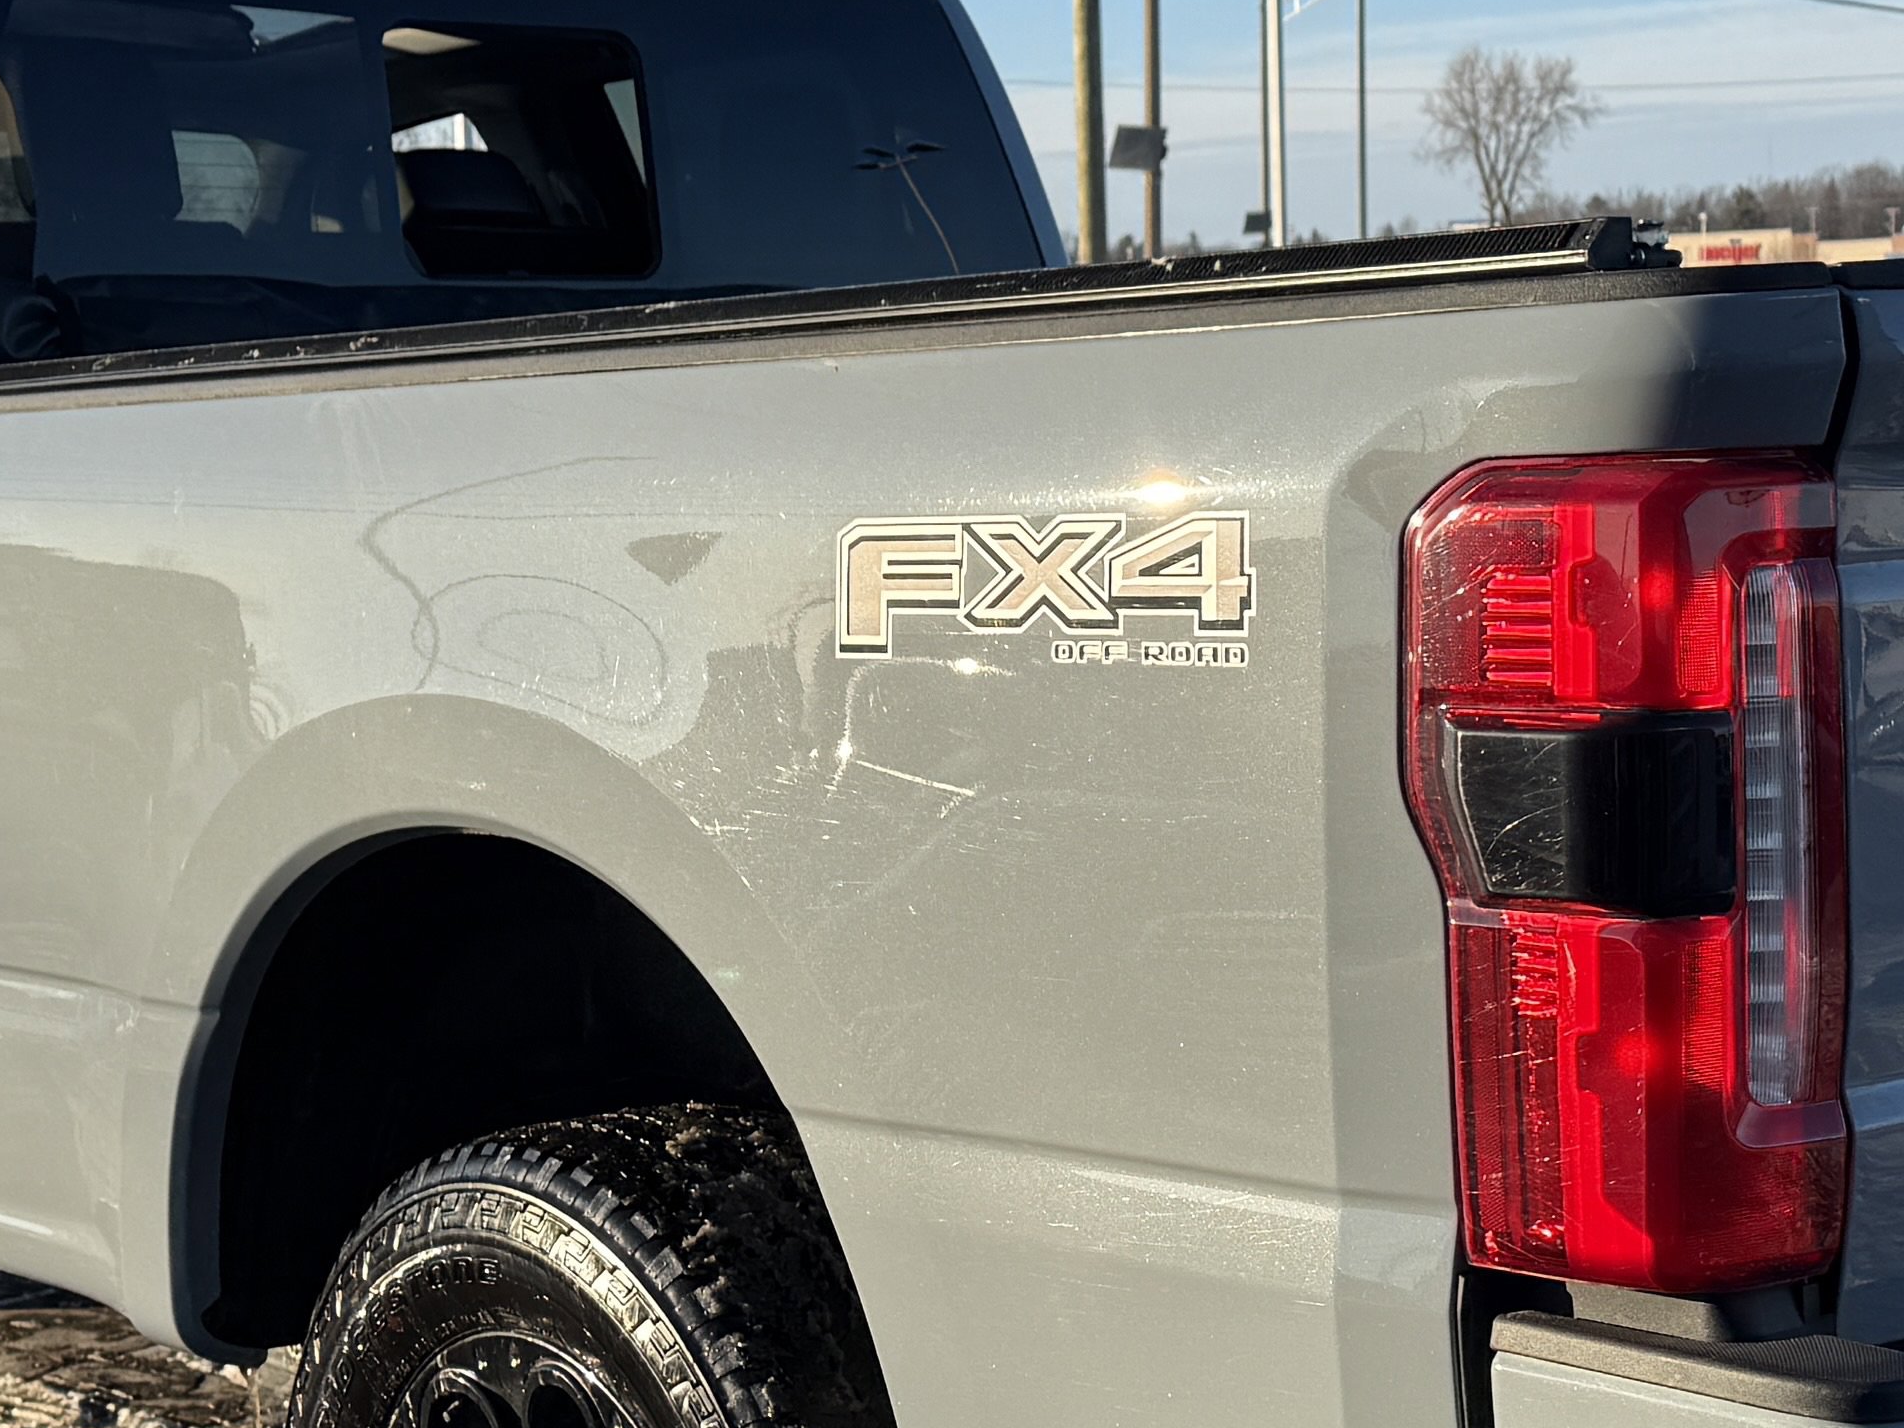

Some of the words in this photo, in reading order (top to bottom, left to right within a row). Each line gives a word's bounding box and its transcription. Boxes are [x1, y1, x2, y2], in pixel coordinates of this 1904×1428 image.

[836, 510, 1256, 659] FX4
[1051, 640, 1127, 664] OFF
[1142, 641, 1249, 667] ROAD
